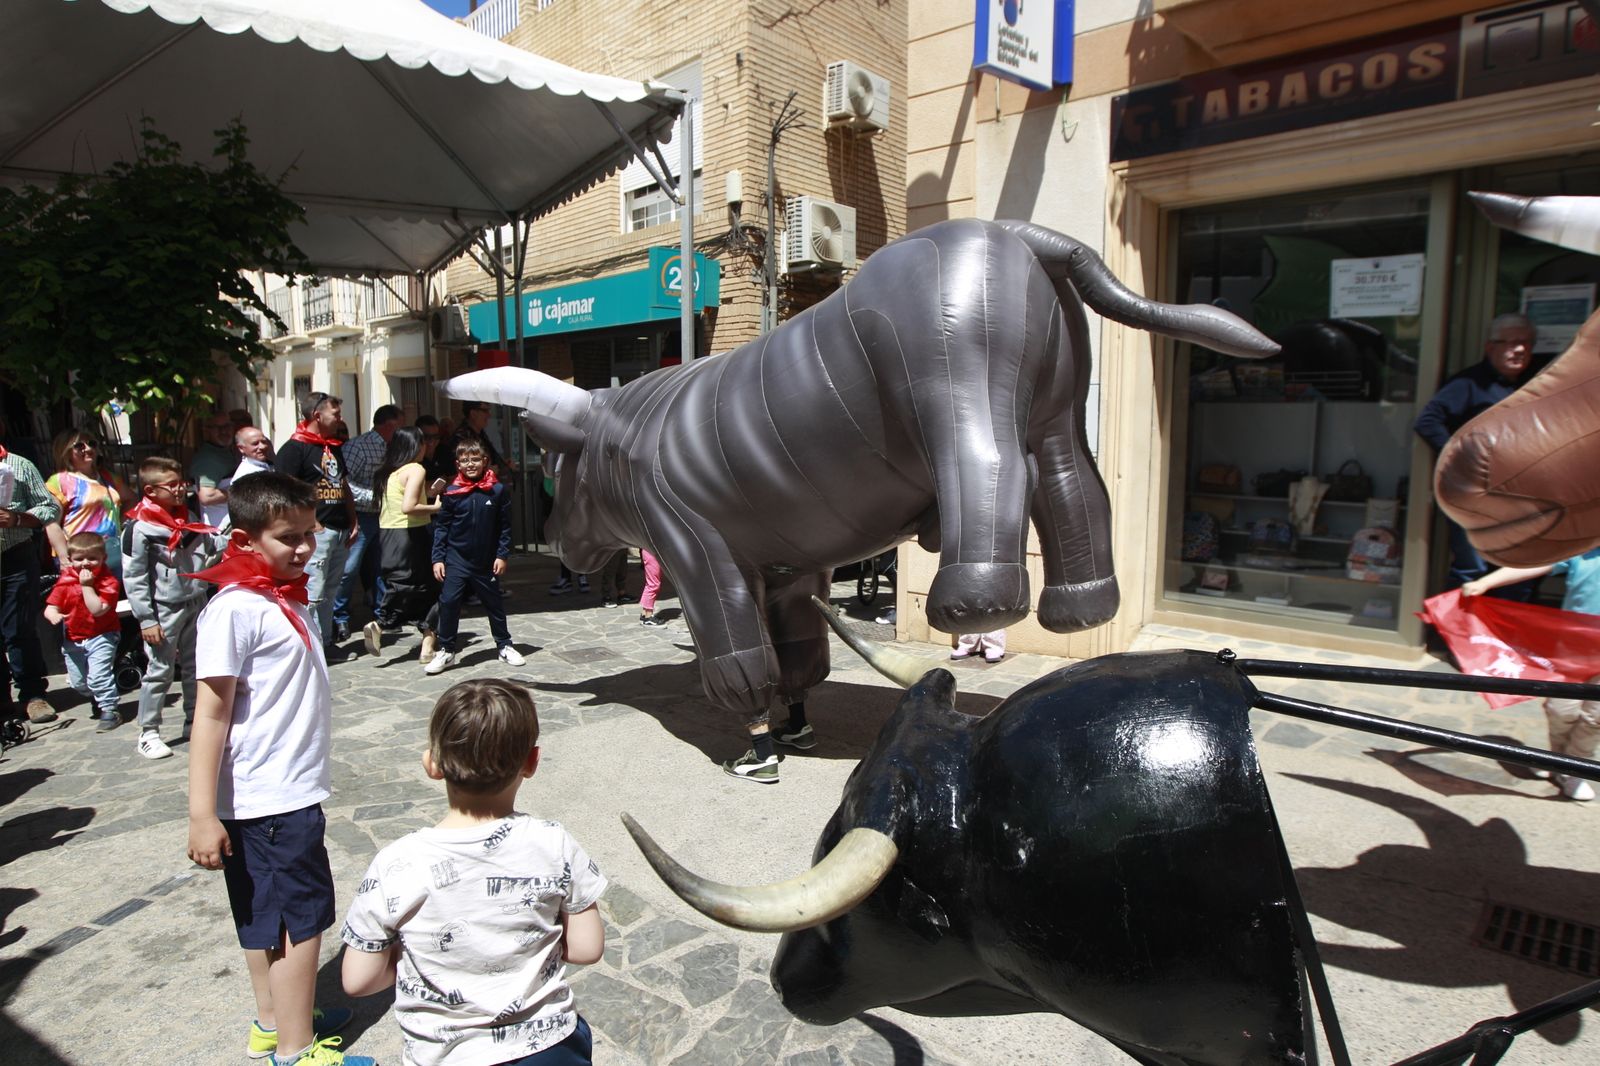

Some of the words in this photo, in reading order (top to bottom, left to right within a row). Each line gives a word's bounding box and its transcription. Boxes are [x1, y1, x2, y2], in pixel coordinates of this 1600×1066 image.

[1171, 42, 1446, 129] TABACOS
[545, 296, 595, 324] cajamar
[568, 315, 579, 325] CAJA
[315, 488, 342, 500] GOON
